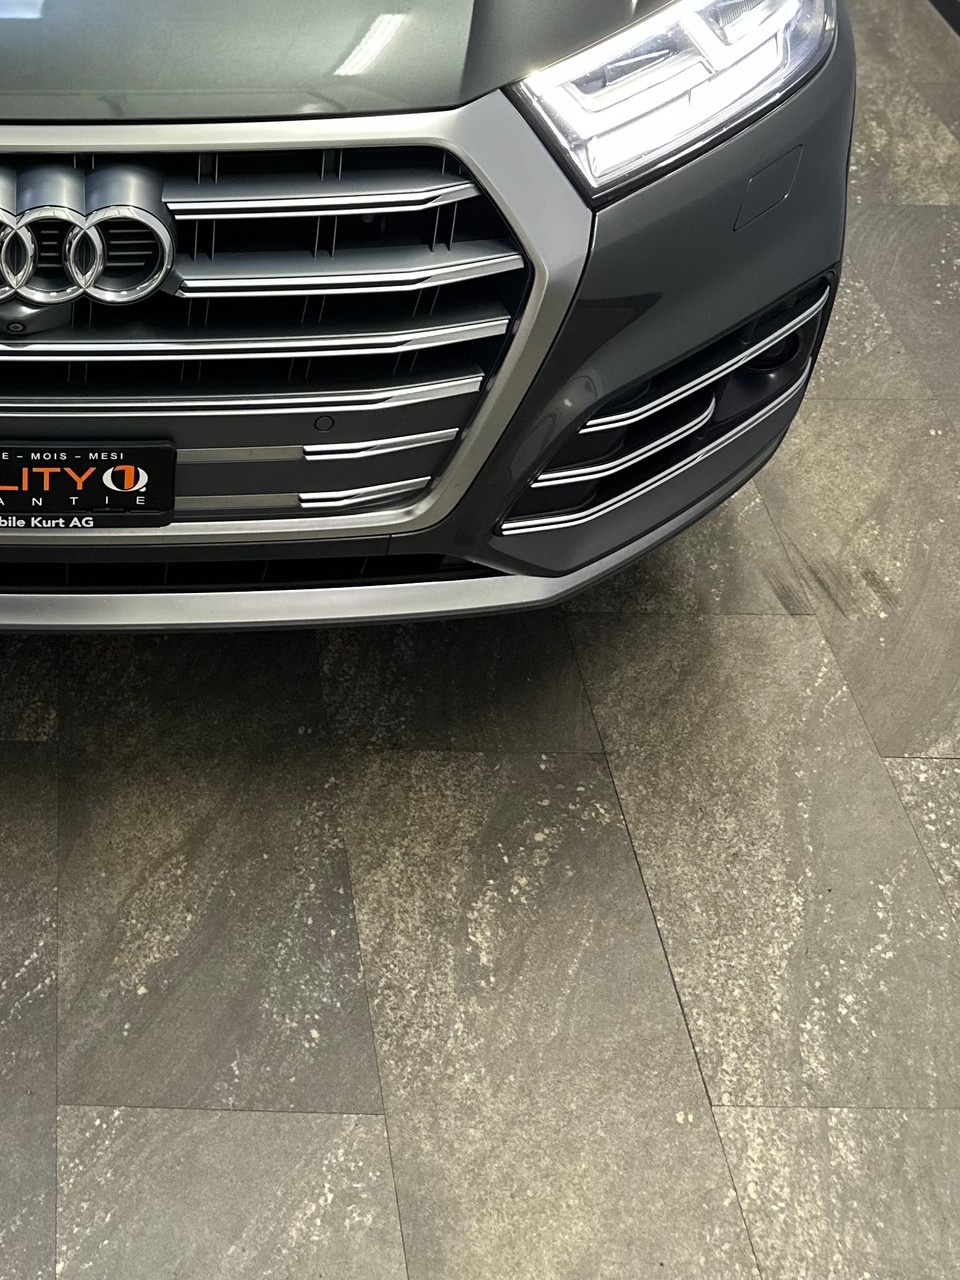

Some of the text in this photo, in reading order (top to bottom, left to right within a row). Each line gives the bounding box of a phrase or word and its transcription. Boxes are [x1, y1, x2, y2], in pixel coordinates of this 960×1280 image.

[31, 452, 67, 460] MOIS
[88, 452, 124, 460] MESI
[31, 516, 66, 528] Kurt
[69, 516, 94, 528] AG
